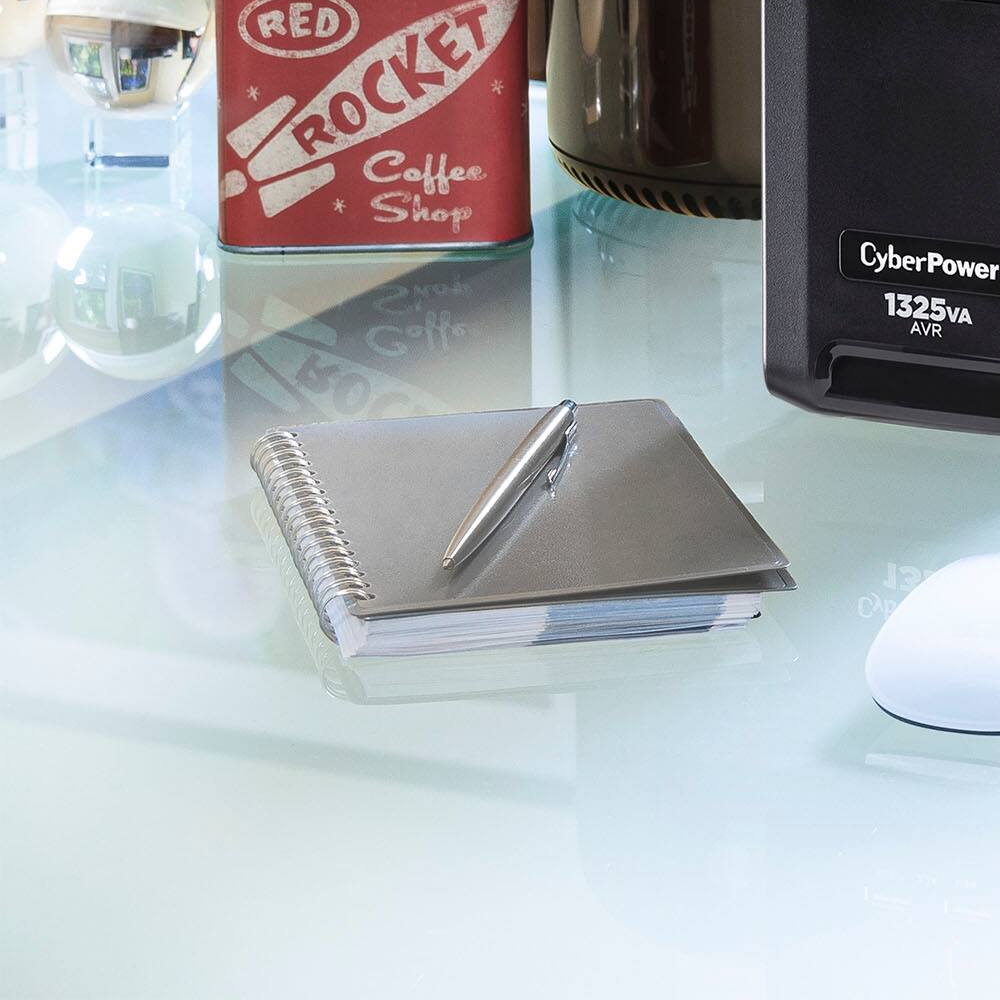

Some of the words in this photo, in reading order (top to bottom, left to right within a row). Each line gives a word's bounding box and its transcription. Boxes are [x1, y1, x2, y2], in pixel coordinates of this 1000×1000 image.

[257, 2, 341, 39] RED
[291, 4, 489, 156] ROCKET
[363, 150, 488, 195] Coffee
[370, 190, 473, 234] Shop
[860, 240, 1000, 281] CyberPower
[884, 292, 973, 326] 1325VA
[910, 321, 943, 338] AVR
